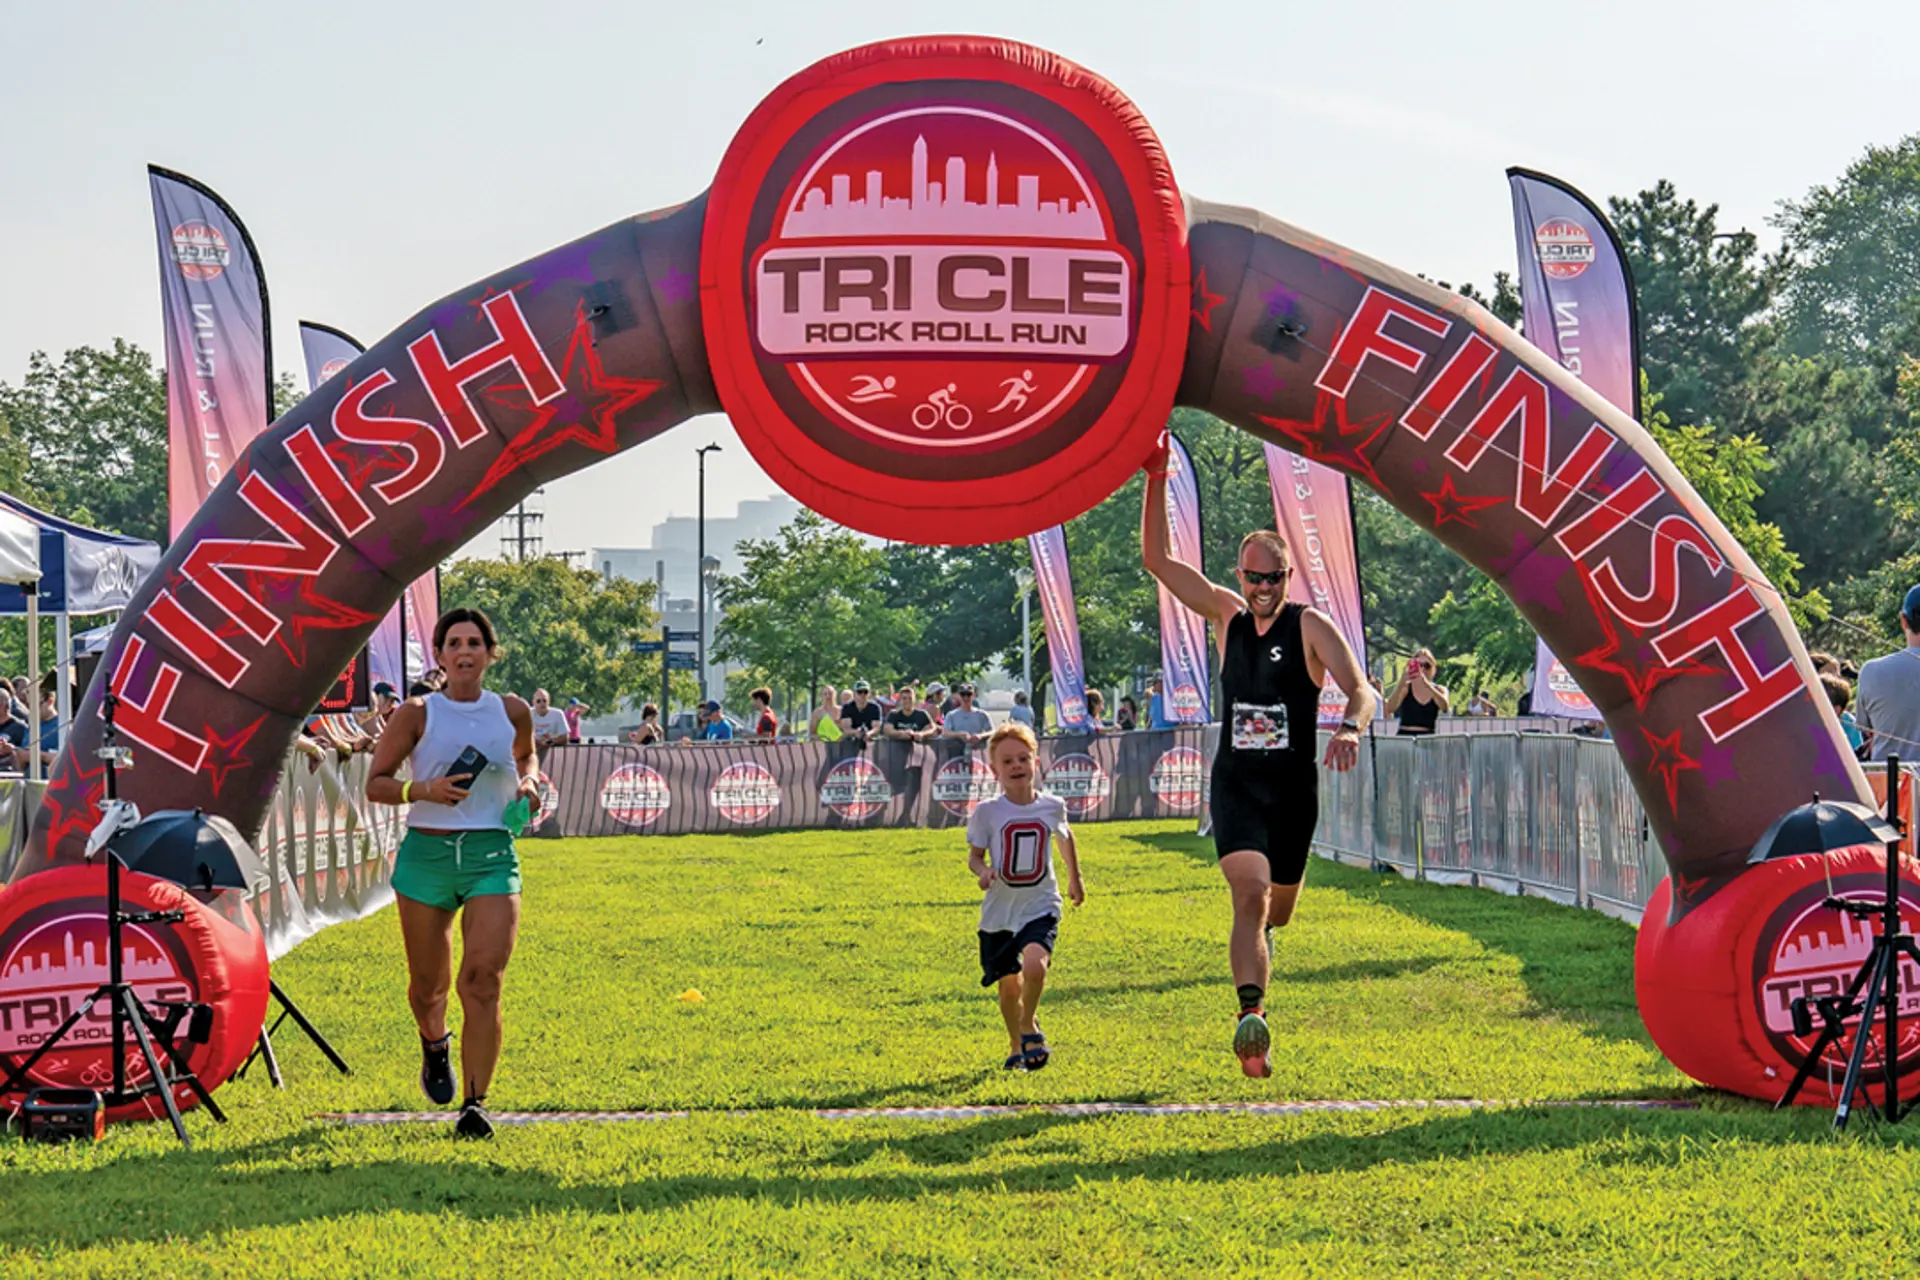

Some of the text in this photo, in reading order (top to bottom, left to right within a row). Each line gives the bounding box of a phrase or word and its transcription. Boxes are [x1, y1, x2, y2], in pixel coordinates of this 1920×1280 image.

[763, 255, 1123, 317] TRI CLE
[804, 321, 1087, 345] ROCK ROLL RUN
[97, 289, 567, 774] FINISH
[1313, 285, 1807, 744] FINISH
[933, 782, 962, 793] TRI
[0, 996, 69, 1031] TRI
[74, 1027, 113, 1041] ROL
